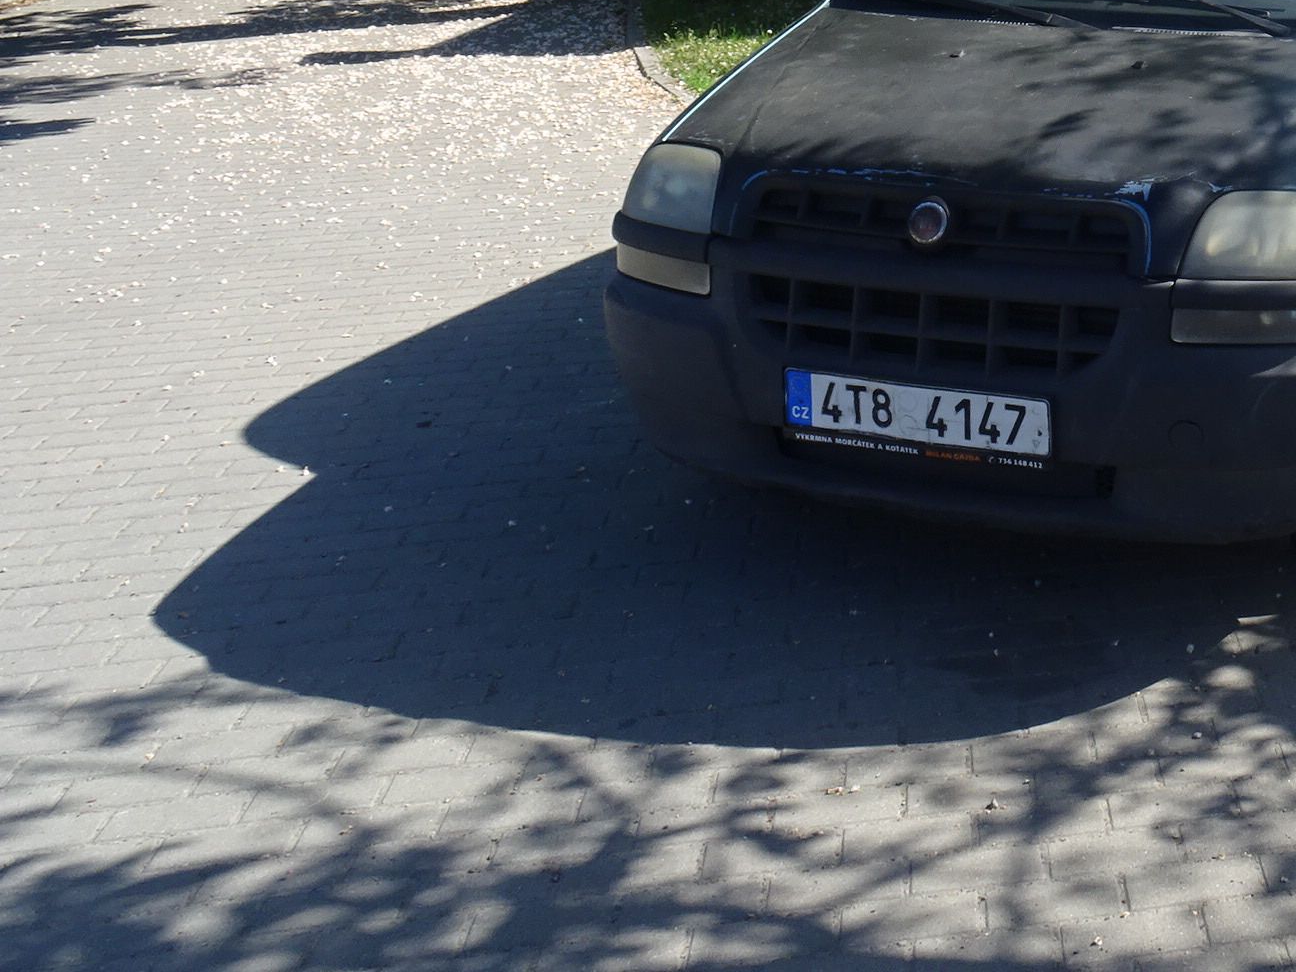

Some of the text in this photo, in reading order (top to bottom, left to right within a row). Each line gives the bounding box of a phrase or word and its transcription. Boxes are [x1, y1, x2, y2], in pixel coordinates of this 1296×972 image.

[792, 405, 809, 420] CZ
[821, 382, 1027, 446] 4T8 4147
